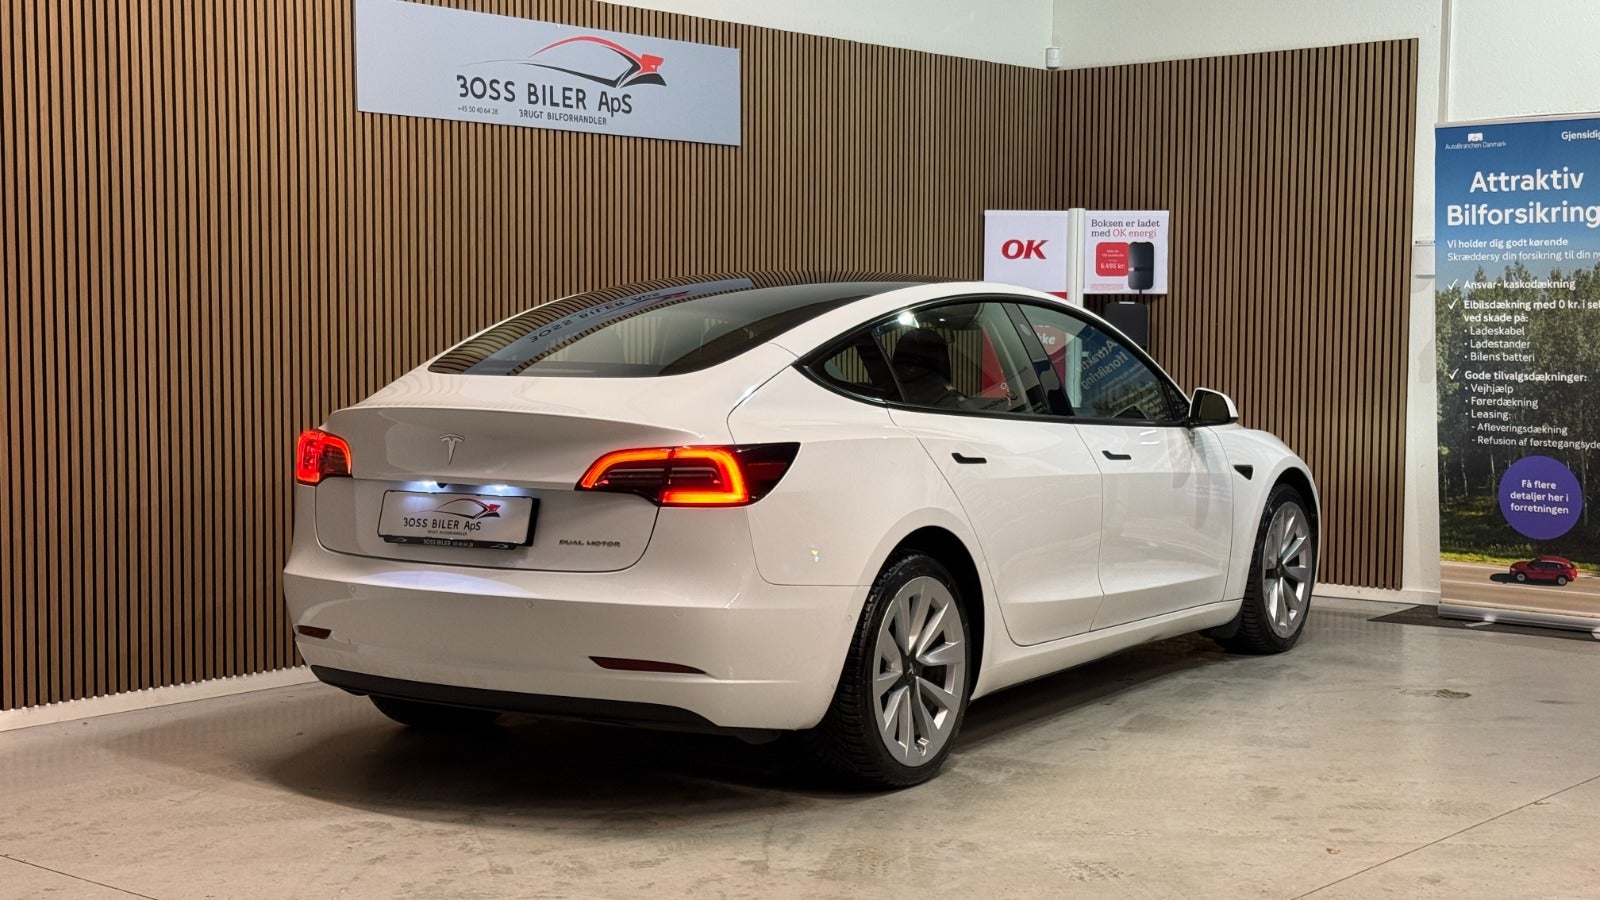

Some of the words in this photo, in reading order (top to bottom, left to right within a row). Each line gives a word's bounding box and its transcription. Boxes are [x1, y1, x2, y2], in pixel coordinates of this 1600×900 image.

[527, 82, 587, 110] BILER
[597, 91, 633, 117] ApS
[476, 106, 484, 114] 40
[547, 112, 607, 126] BILFORHANDLER
[1482, 140, 1507, 149] Danmark
[1469, 166, 1584, 193] Attraktiv
[1447, 200, 1600, 228] Bilforsikring
[1091, 218, 1123, 228] Boksen
[1125, 220, 1135, 228] er
[1137, 218, 1160, 228] ladet
[1091, 228, 1111, 237] med
[1112, 228, 1126, 237] OK
[1128, 228, 1157, 239] energi
[1001, 239, 1049, 260] OK
[1447, 239, 1457, 248] Vi
[1458, 238, 1487, 248] holder
[1489, 238, 1504, 250] dig
[1505, 238, 1527, 250] godt
[1528, 237, 1568, 247] kørende
[1447, 252, 1500, 263] Skræddersy
[1502, 251, 1517, 261] din
[1518, 250, 1562, 262] forsikring
[1563, 250, 1574, 260] til
[1575, 250, 1590, 260] din
[1463, 280, 1501, 290] Ansvar-
[1503, 279, 1576, 291] kaskodækning
[1463, 299, 1532, 312] Elbilsdækning
[1533, 300, 1556, 310] med
[1558, 299, 1565, 310] 0
[1567, 300, 1581, 310] kr.
[1463, 313, 1482, 323] ved
[1483, 313, 1512, 323] skade
[1514, 313, 1529, 325] på:
[1470, 326, 1525, 336] Ladeskabel
[1470, 339, 1531, 349] Ladestander
[1470, 352, 1500, 362] Bilens
[1502, 352, 1535, 362] batteri
[1464, 370, 1492, 380] Gode
[1493, 370, 1587, 383] tilvalgsdækninger:
[1470, 384, 1514, 396] Vejhjælp
[1471, 397, 1539, 409] Førerdækning
[1471, 410, 1511, 420] Leasing:
[1477, 422, 1568, 435] Afleveringsdækning
[1477, 436, 1517, 447] Refusion
[1518, 437, 1528, 447] af
[1521, 479, 1532, 489] Få
[1533, 480, 1557, 490] flere
[1510, 491, 1546, 503] detaljer
[1547, 493, 1563, 502] her
[1565, 493, 1569, 502] i
[1510, 503, 1569, 515] forretningen
[431, 519, 459, 530] BILER
[463, 521, 482, 533] ApS
